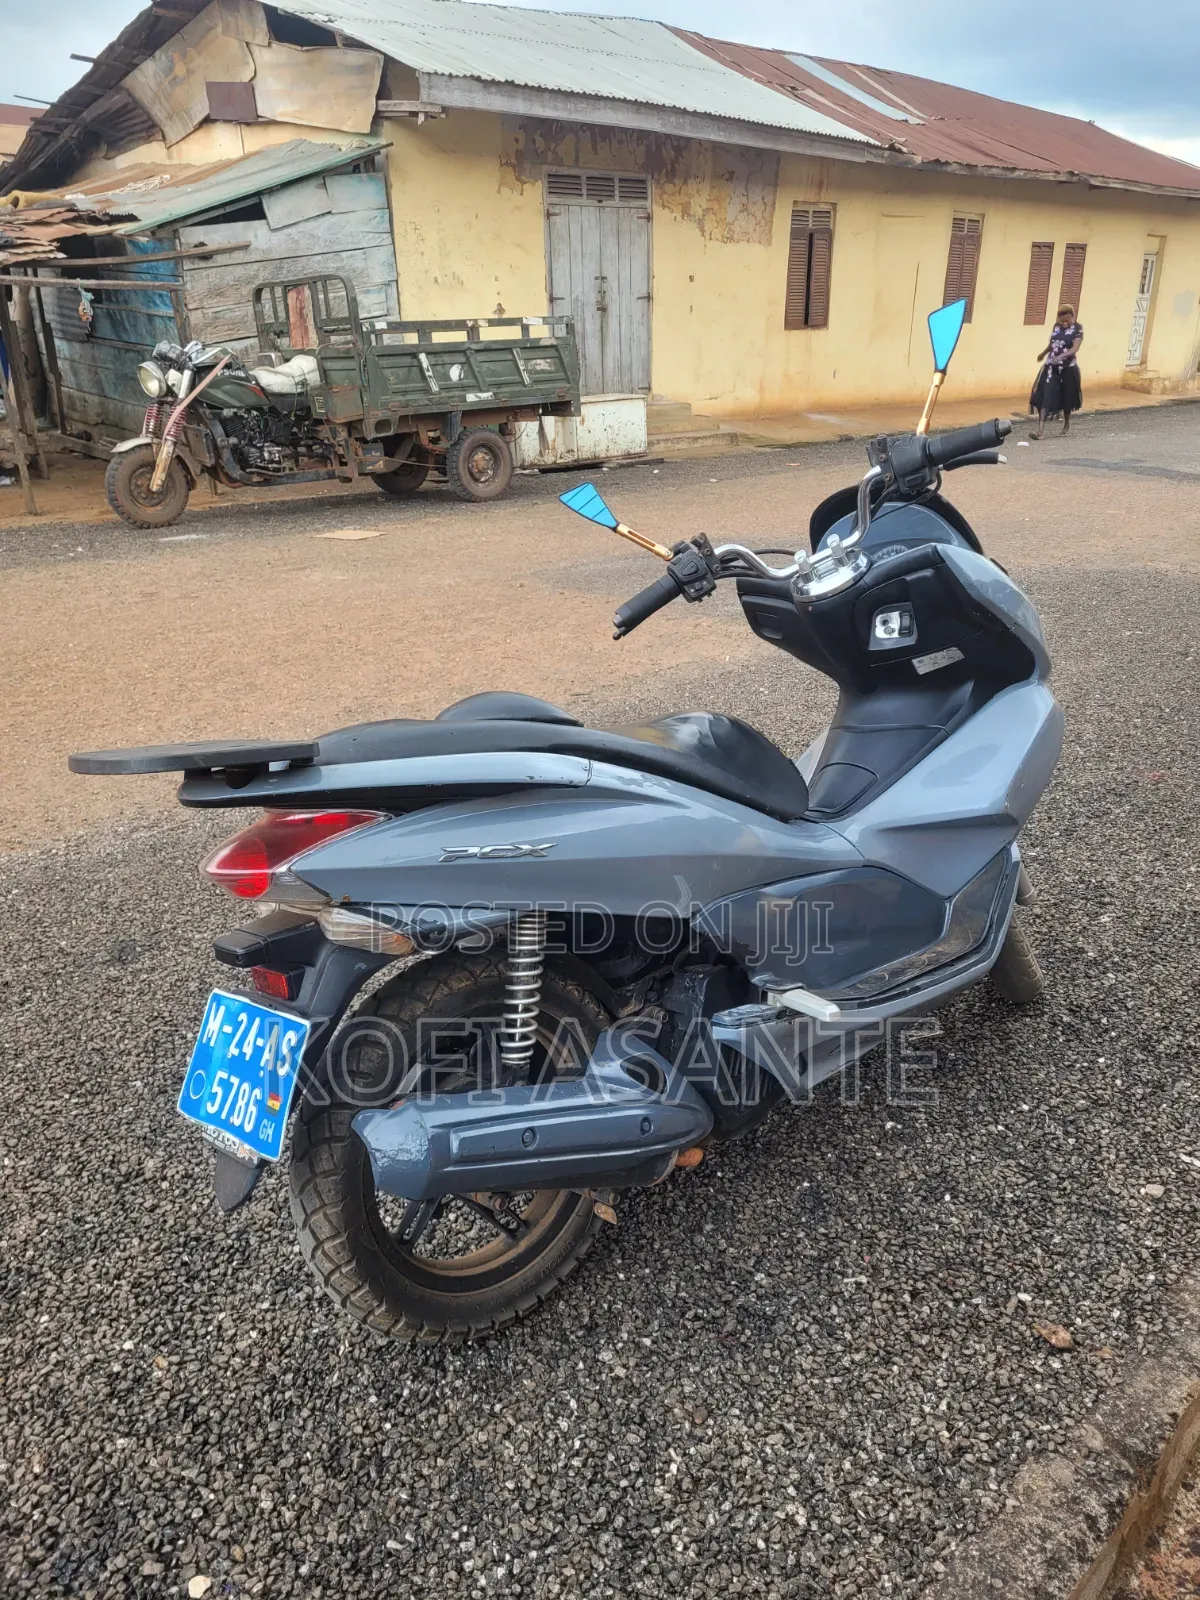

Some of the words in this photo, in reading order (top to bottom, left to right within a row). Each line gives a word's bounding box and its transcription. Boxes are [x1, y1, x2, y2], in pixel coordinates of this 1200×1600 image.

[438, 842, 558, 862] PCX
[202, 1002, 298, 1077] M-24-AS
[206, 1070, 262, 1133] 5786
[258, 1118, 276, 1143] GH
